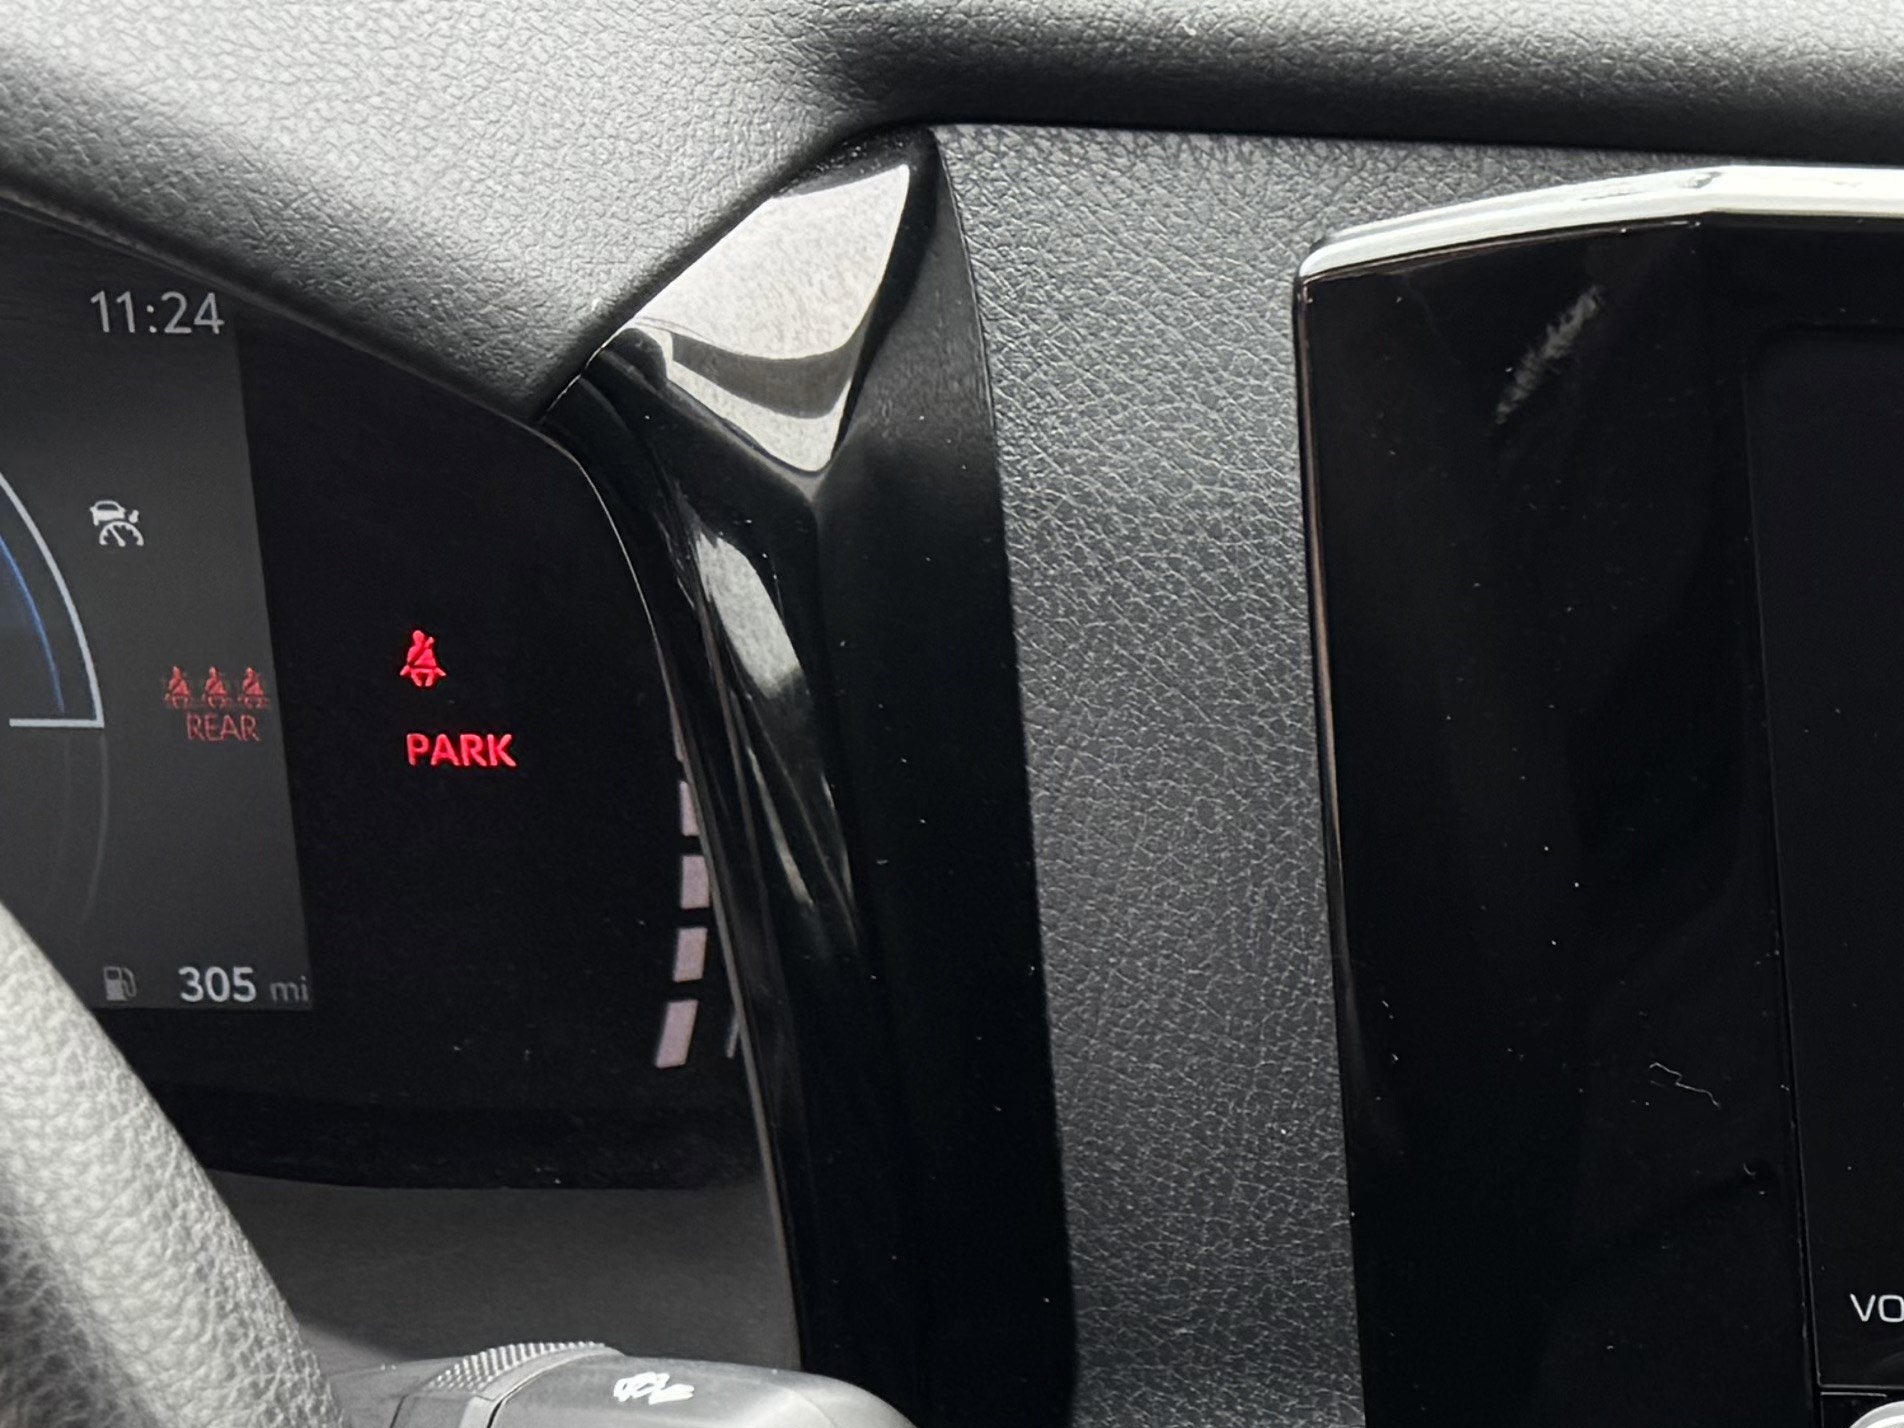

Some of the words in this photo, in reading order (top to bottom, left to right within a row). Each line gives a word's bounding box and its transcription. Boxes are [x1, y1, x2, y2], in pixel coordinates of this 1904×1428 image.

[90, 290, 225, 335] 11:24
[186, 712, 259, 741] REAR
[406, 733, 517, 767] PARK
[178, 966, 257, 1003] 305
[269, 975, 309, 1002] mi
